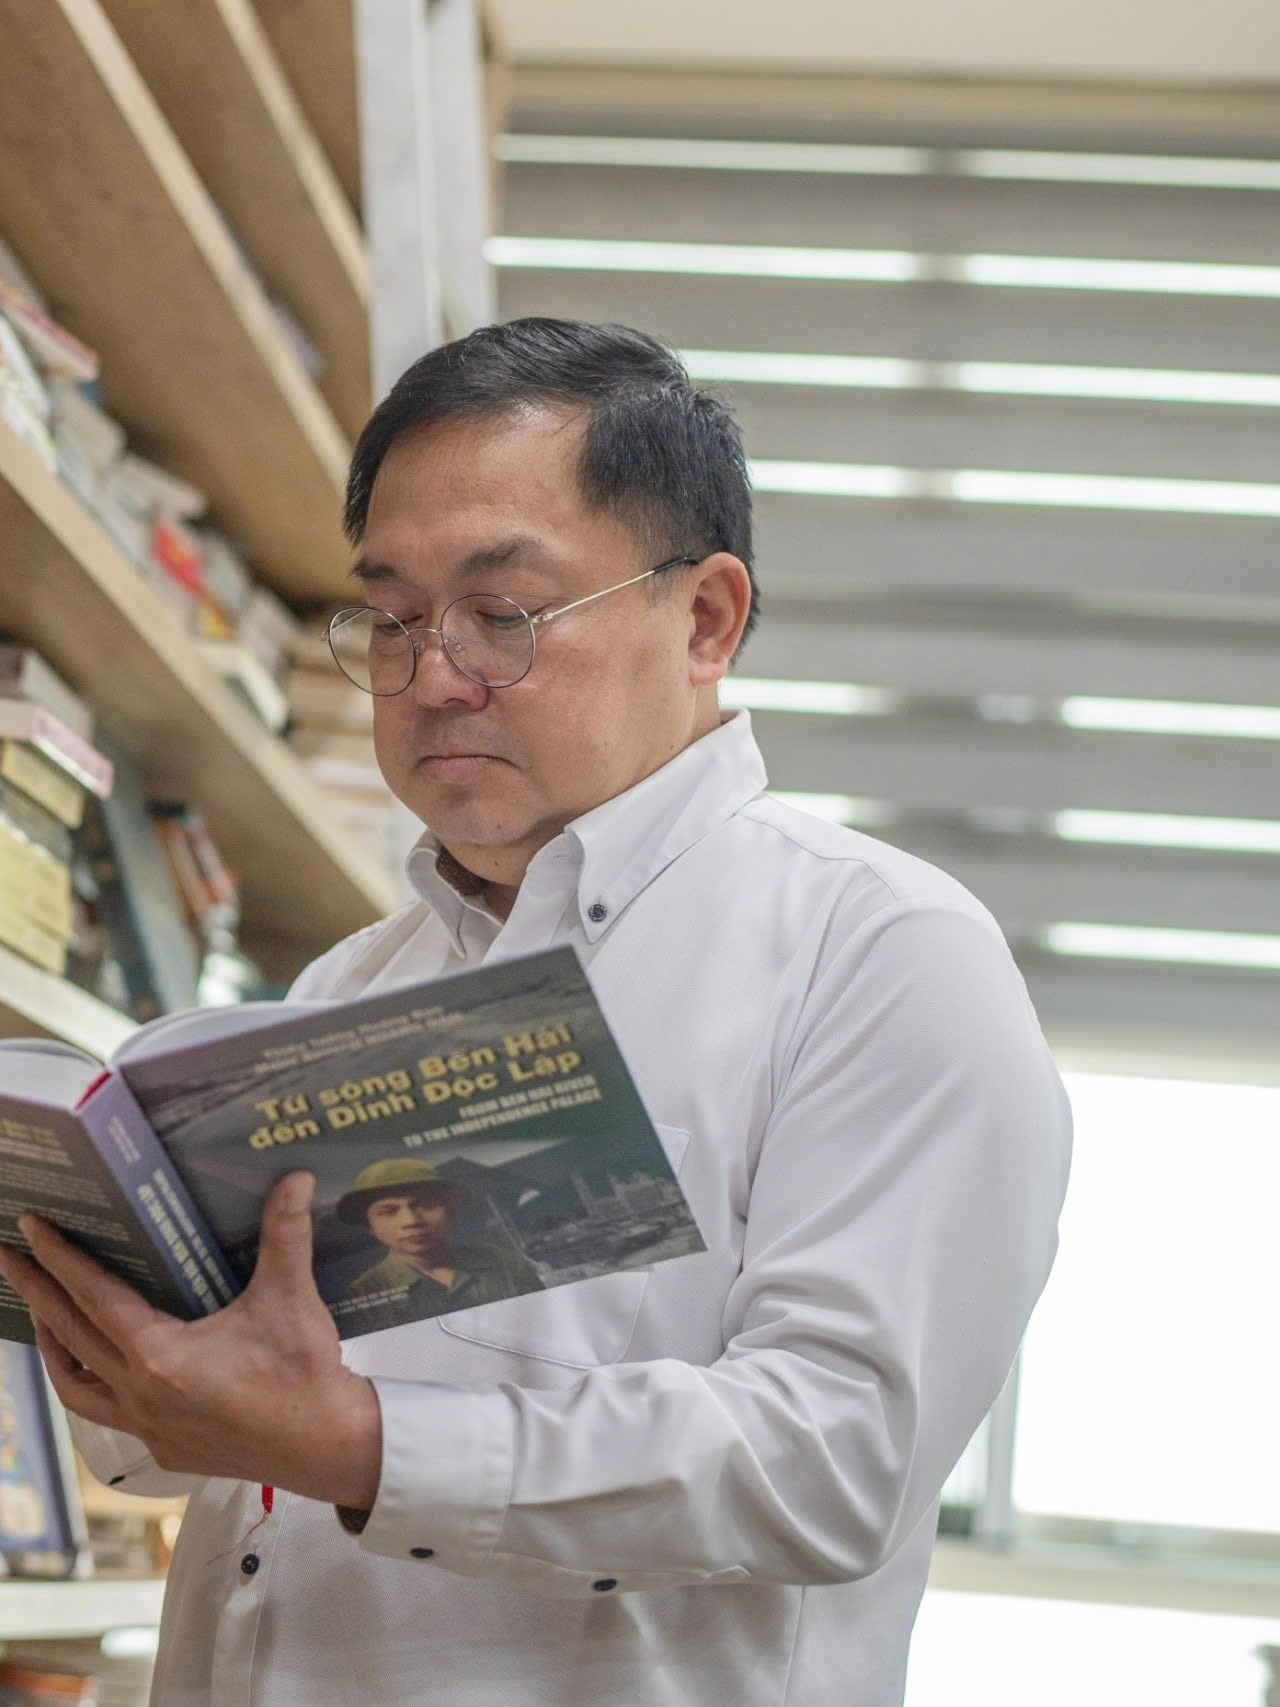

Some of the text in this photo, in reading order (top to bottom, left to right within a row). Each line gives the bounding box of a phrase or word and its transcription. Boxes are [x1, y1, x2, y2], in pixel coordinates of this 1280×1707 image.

[318, 1068, 411, 1107] sông
[325, 1092, 415, 1130] Dinh
[423, 1126, 450, 1143] THE
